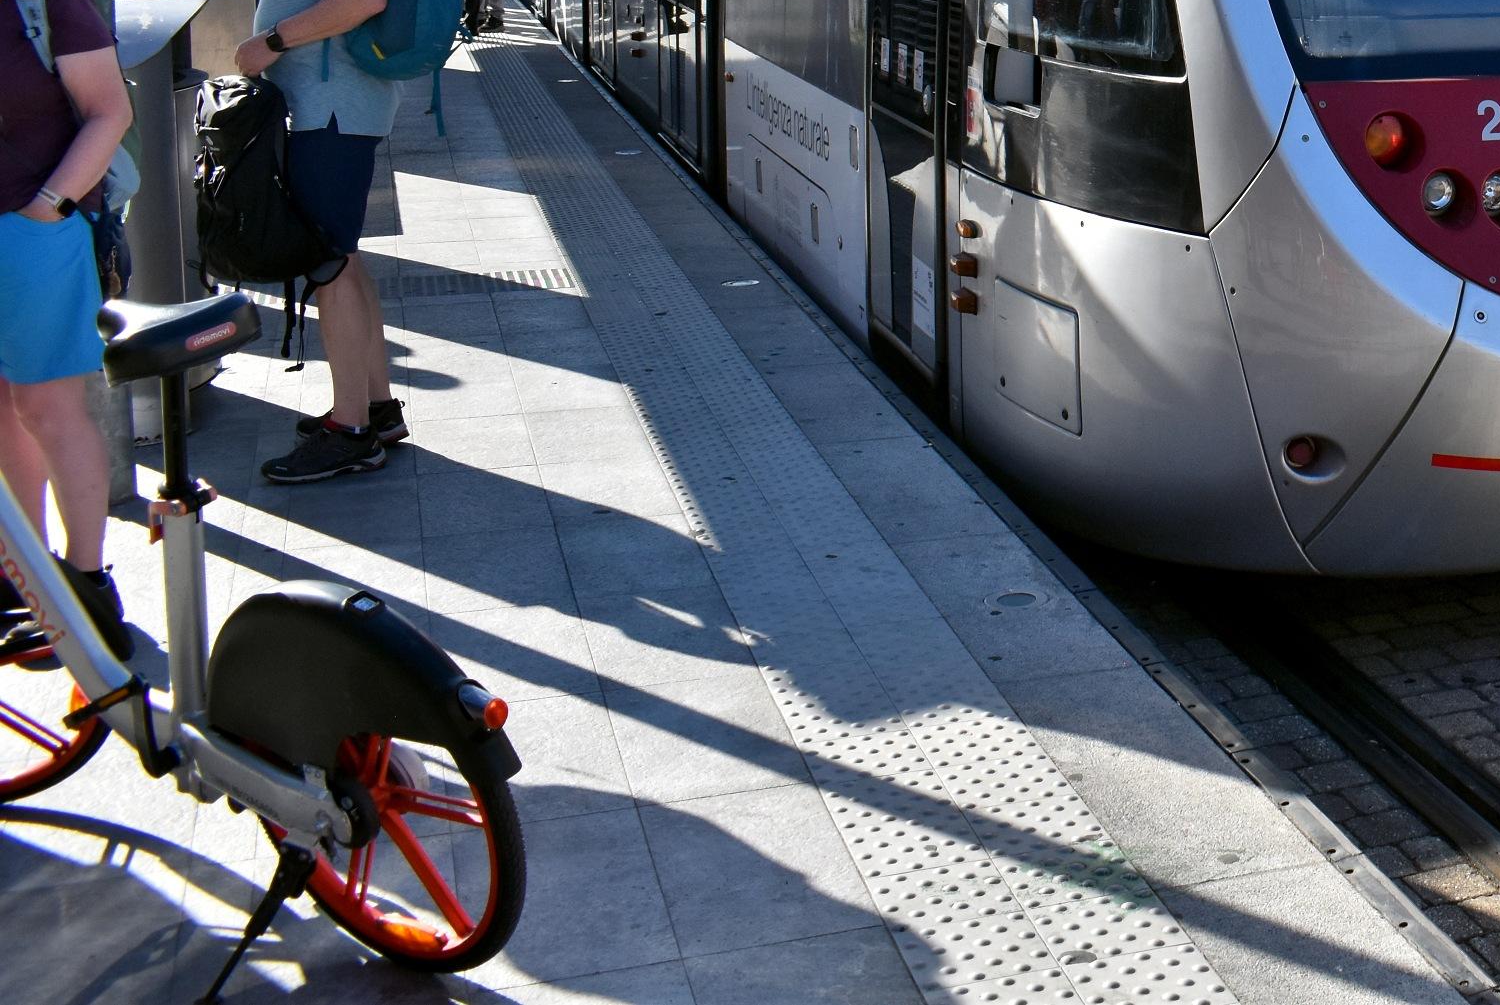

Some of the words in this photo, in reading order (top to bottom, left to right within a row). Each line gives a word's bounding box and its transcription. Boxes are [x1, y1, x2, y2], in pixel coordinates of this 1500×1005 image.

[746, 71, 793, 138] L'intelligenza
[793, 107, 830, 162] naturale
[193, 325, 230, 347] ridemovi
